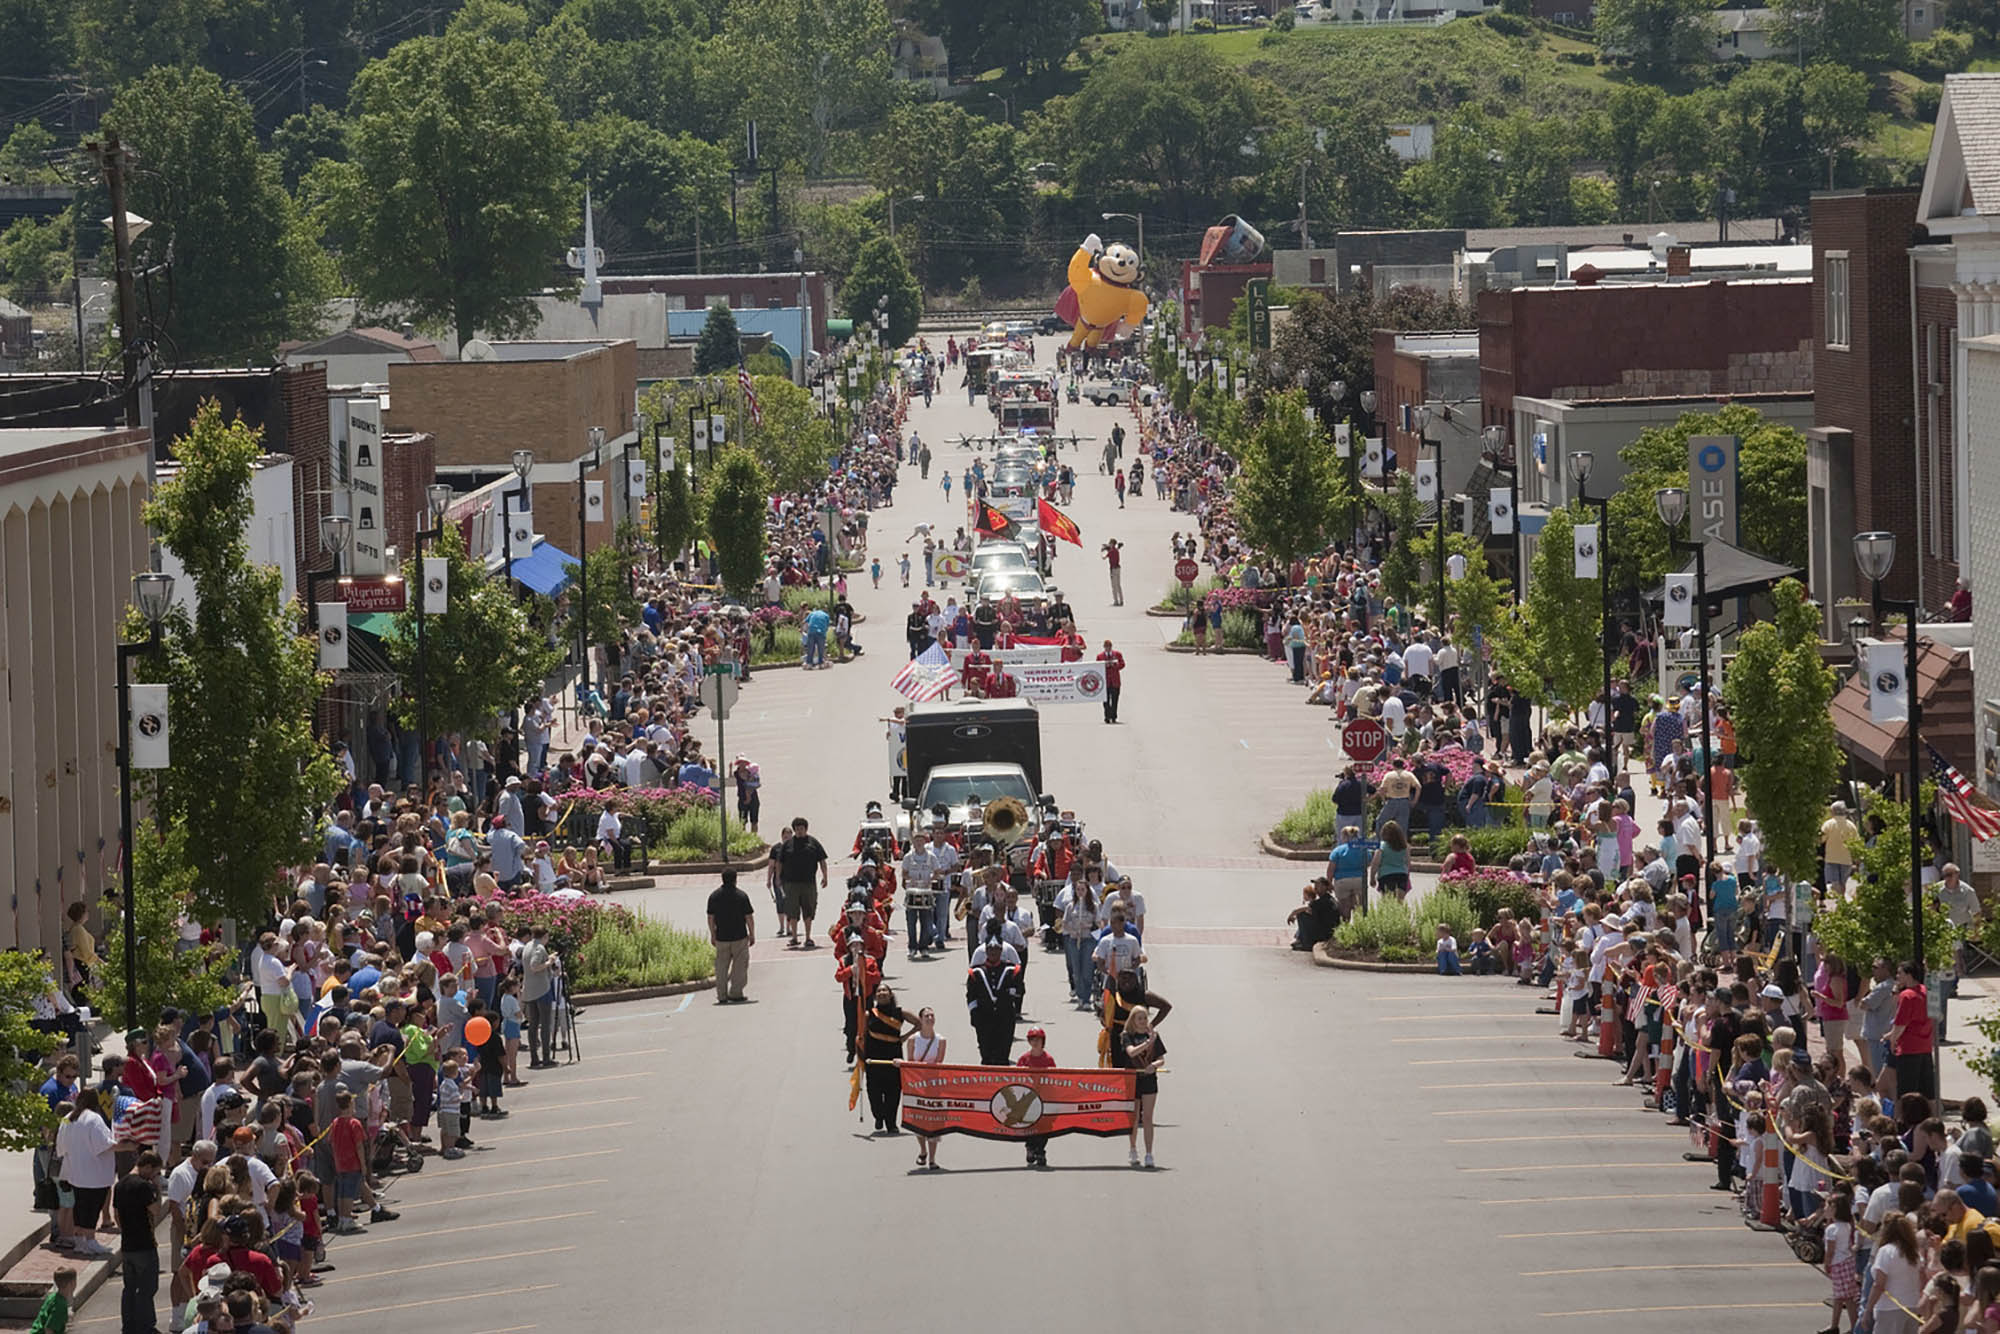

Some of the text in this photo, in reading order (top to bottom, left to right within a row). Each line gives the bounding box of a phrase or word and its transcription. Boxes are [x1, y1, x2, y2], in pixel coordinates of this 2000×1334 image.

[350, 416, 377, 434] BOOKS
[357, 541, 378, 559] GIFTS
[1176, 565, 1197, 576] STOP
[343, 584, 392, 598] Pilgrim's
[347, 597, 397, 609] Progress
[1025, 675, 1074, 683] THOMAS
[1345, 731, 1382, 747] STOP
[907, 1075, 1125, 1095] SOUTH CHARLESTON HIGH SCHOOL
[916, 1099, 1103, 1111] BLACK EAGLE BAND
